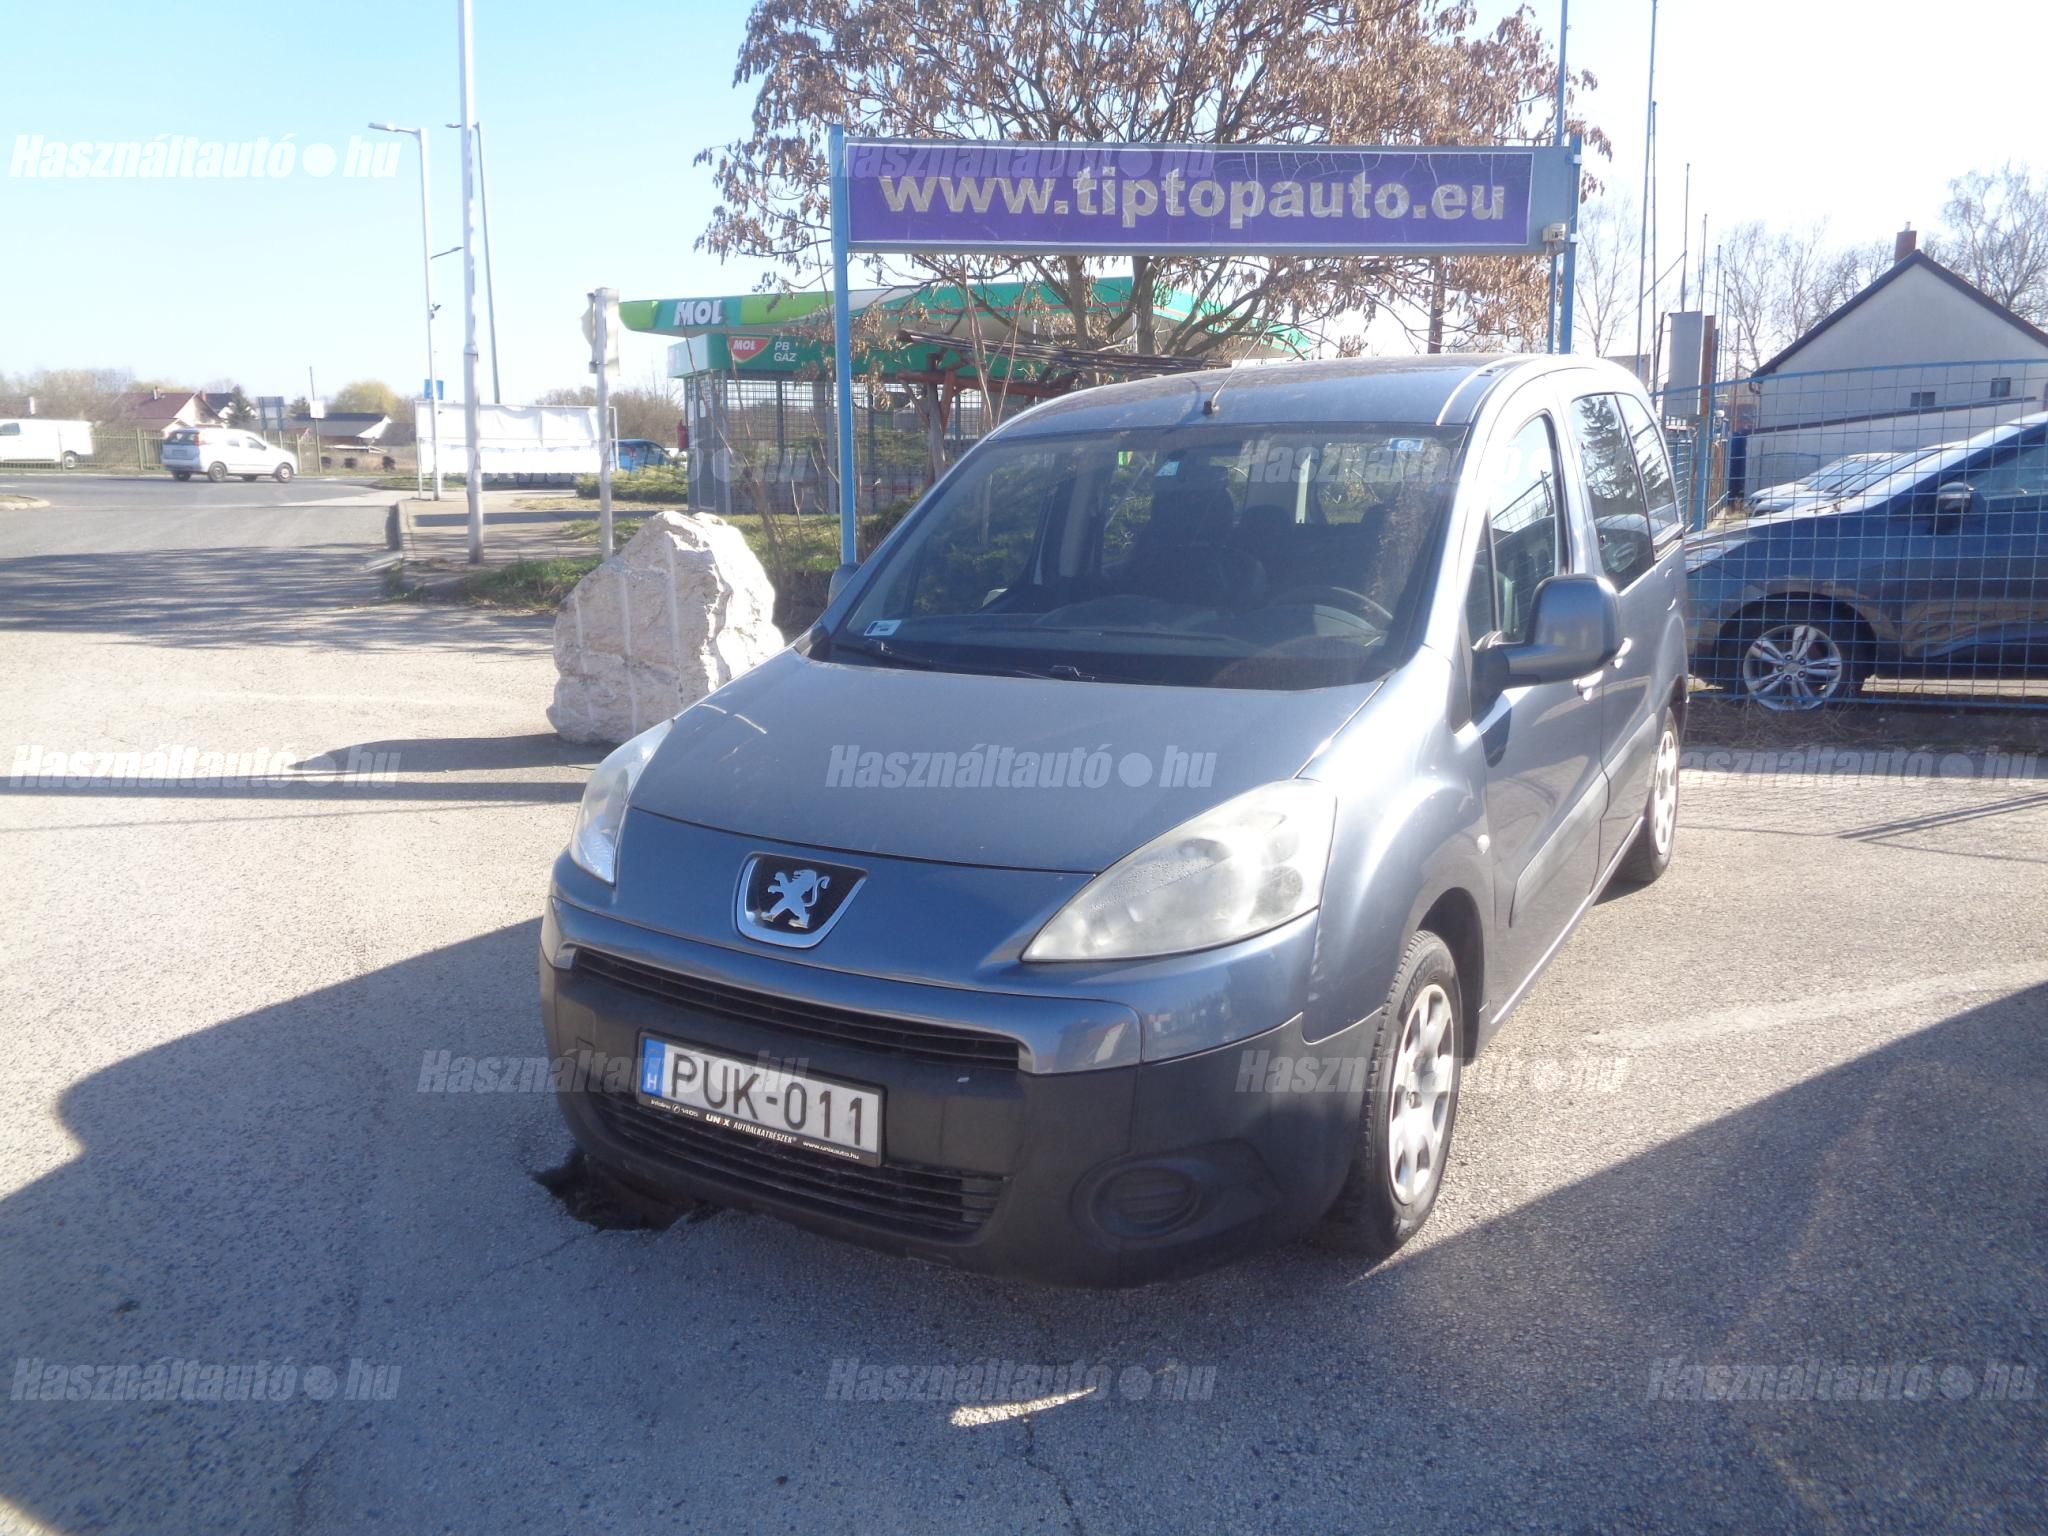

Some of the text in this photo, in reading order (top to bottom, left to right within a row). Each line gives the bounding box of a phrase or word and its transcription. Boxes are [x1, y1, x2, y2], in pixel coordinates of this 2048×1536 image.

[878, 165, 1505, 229] www.tiptopauto.eu
[673, 300, 723, 326] MOL
[733, 339, 756, 351] MOL
[775, 341, 790, 351] PB
[647, 1073, 657, 1090] H
[671, 1053, 863, 1146] PUK-011
